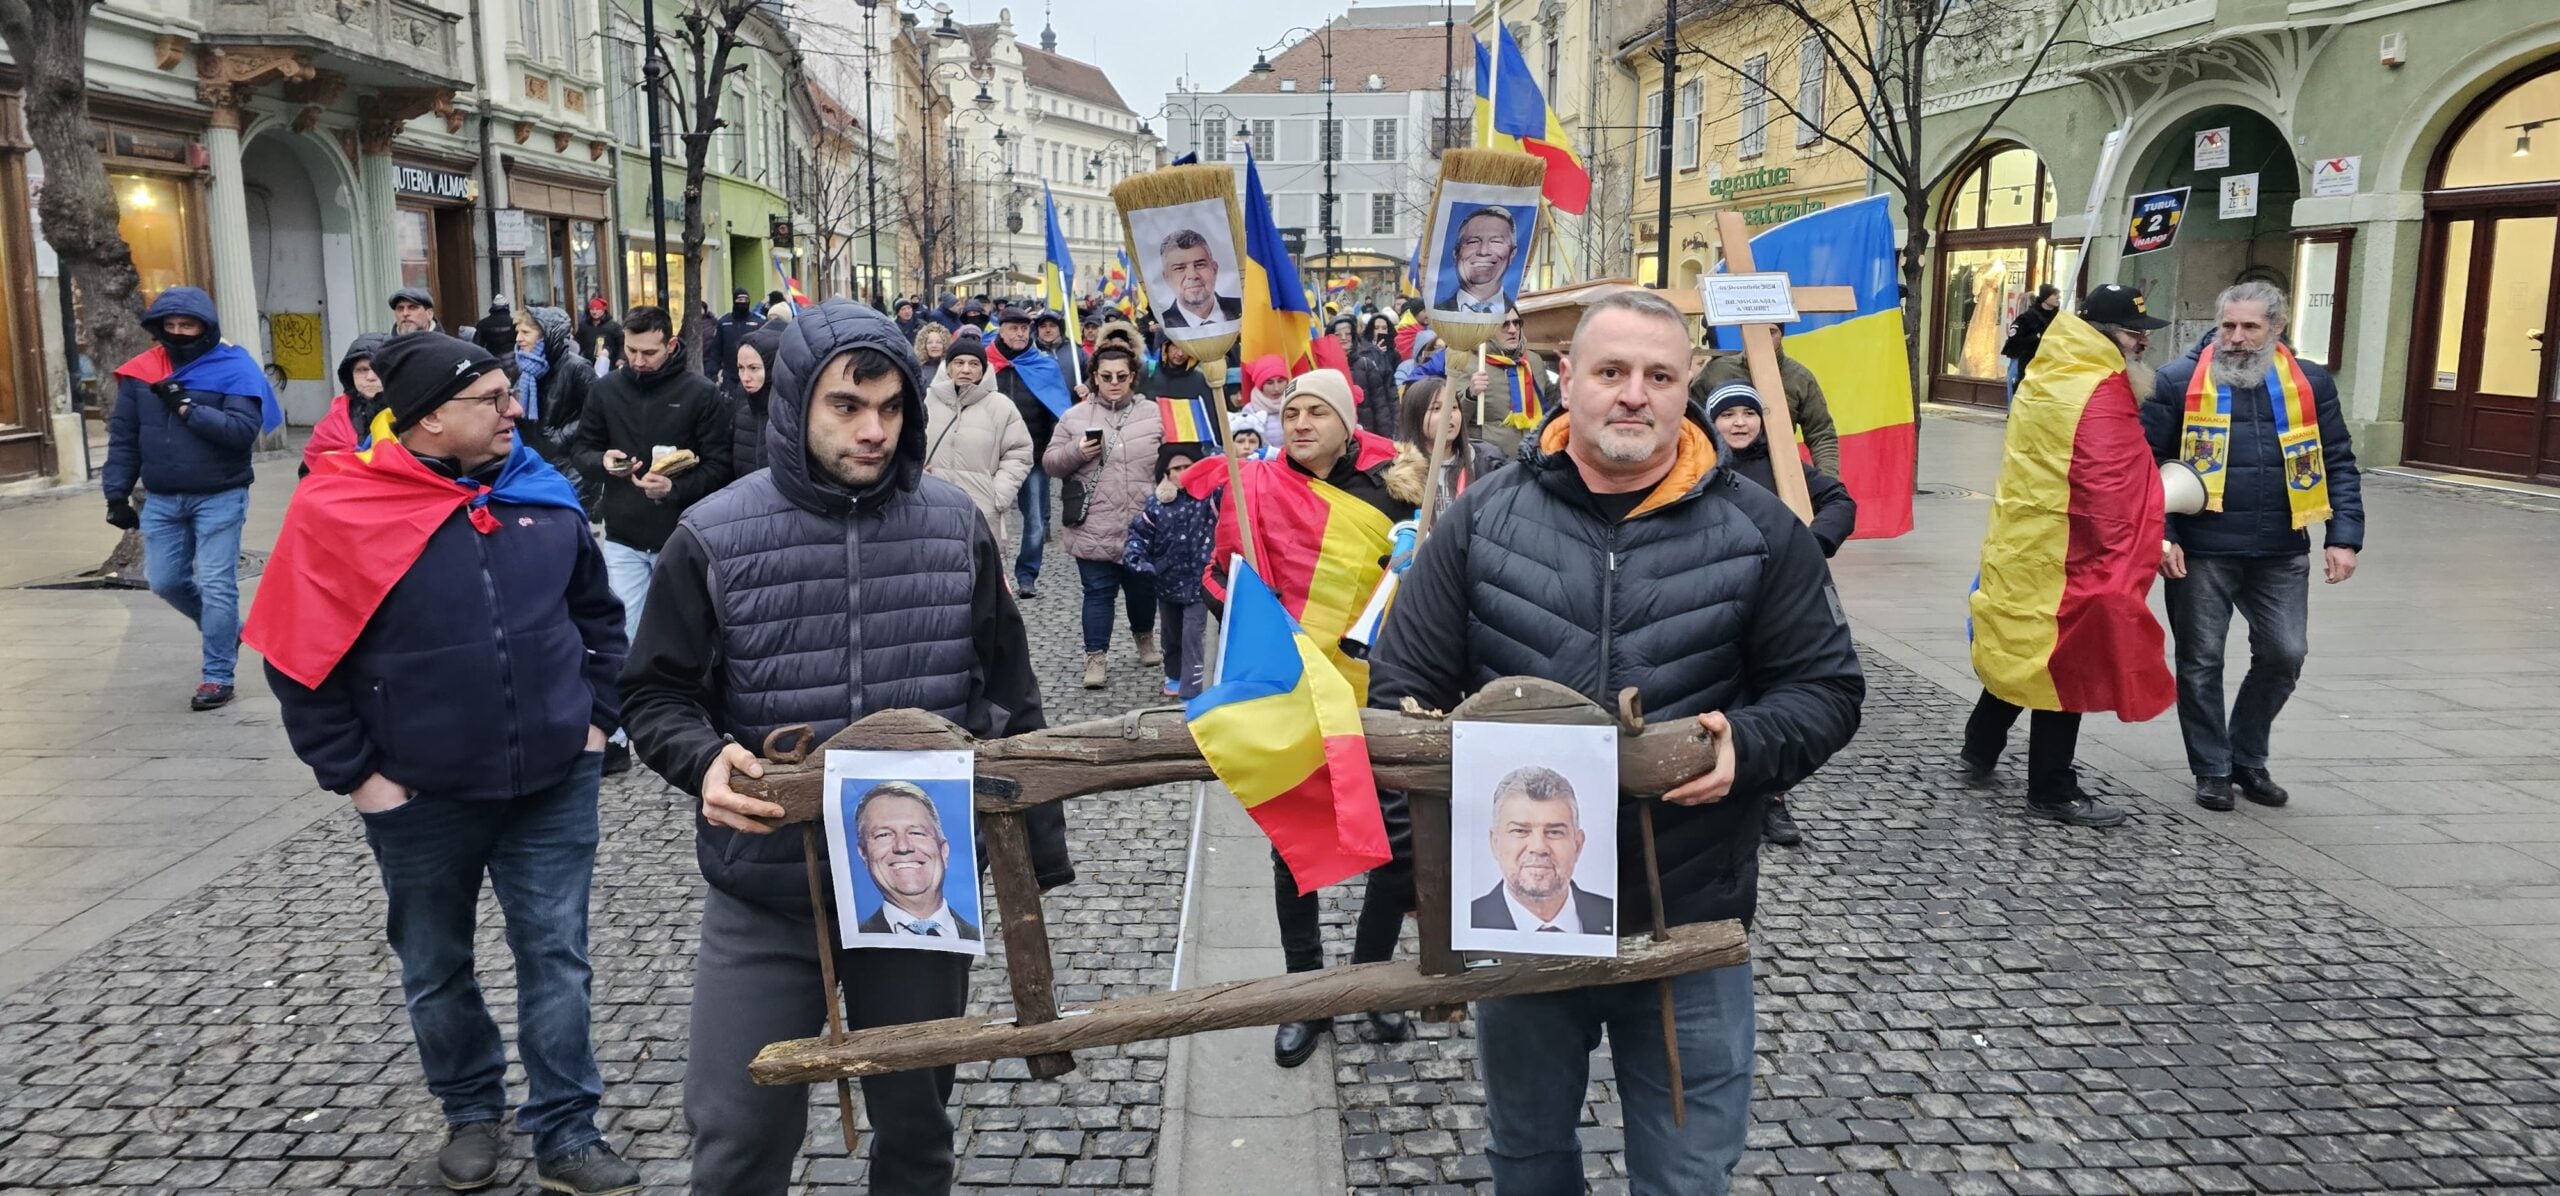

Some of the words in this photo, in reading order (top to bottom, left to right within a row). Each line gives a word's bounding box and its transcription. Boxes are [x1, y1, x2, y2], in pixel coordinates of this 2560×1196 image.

[1709, 166, 1789, 201] agentie
[2144, 199, 2178, 212] TURUL
[2147, 214, 2163, 233] 2
[2188, 415, 2228, 424] ROMANIA
[2282, 430, 2315, 442] ROMANIA
